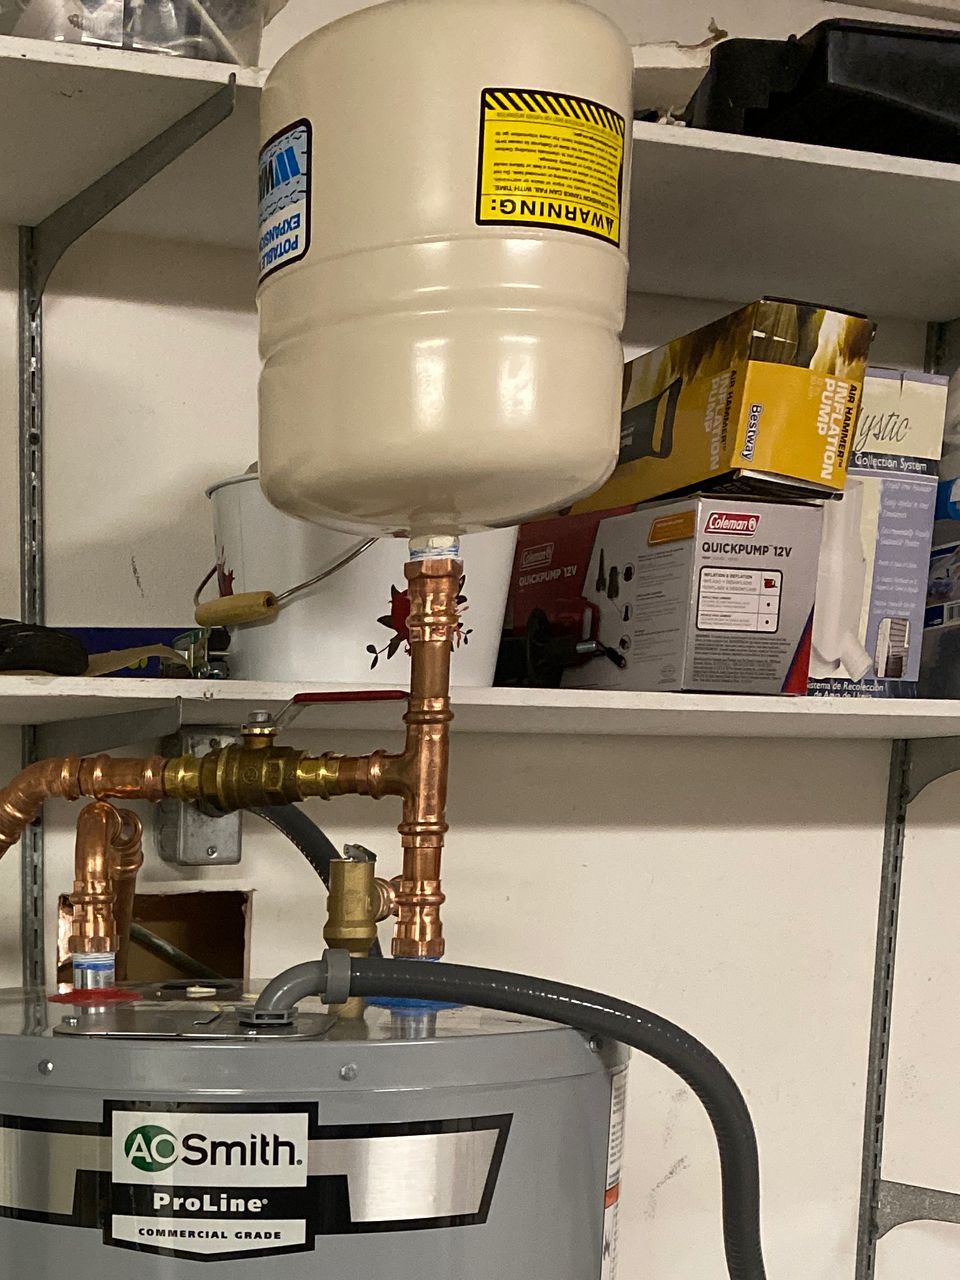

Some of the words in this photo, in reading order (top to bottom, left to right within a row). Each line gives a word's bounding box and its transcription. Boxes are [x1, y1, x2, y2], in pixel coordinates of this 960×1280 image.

[491, 199, 605, 230] WARNING:
[849, 384, 858, 404] AIR
[816, 377, 835, 436] PUMP
[741, 403, 762, 462] Bestway
[820, 381, 849, 480] INFLATION
[855, 407, 909, 453] ystic
[900, 458, 927, 472] System
[709, 514, 748, 530] Coleman
[773, 546, 792, 558] 12V
[563, 565, 578, 577] 12V
[832, 681, 841, 690] de
[138, 1227, 229, 1239] COMMERCIAL
[234, 1231, 282, 1240] GRADE
